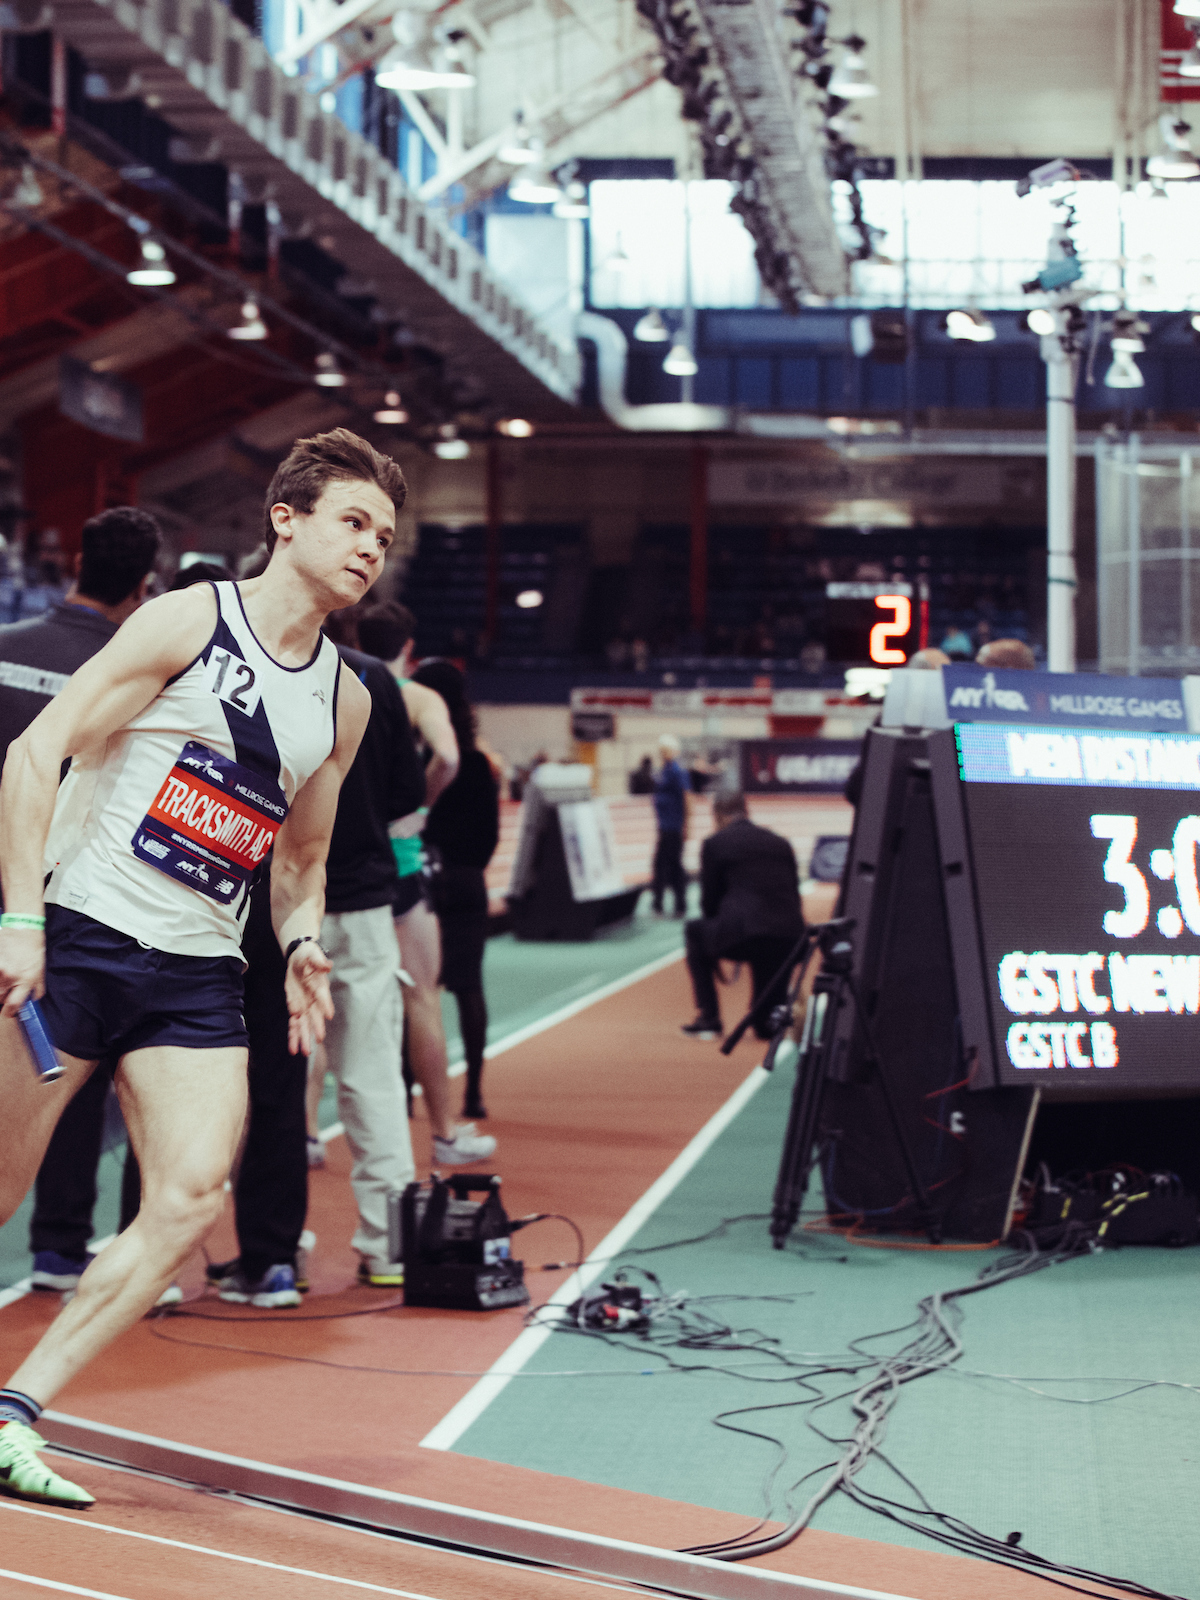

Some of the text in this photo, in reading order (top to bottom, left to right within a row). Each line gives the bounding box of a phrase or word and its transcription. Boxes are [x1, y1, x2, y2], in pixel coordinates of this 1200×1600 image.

[869, 594, 911, 664] 2
[211, 653, 256, 710] 12
[1051, 694, 1127, 717] MILLROSE
[1126, 697, 1184, 719] GAMES
[1007, 732, 1083, 779] MEN
[156, 775, 274, 862] TRACKSMITH AC
[234, 783, 266, 806] MILLROSE
[262, 799, 286, 817] GAMES
[998, 951, 1111, 1015] GSTC
[1006, 1021, 1119, 1069] GSTC B
